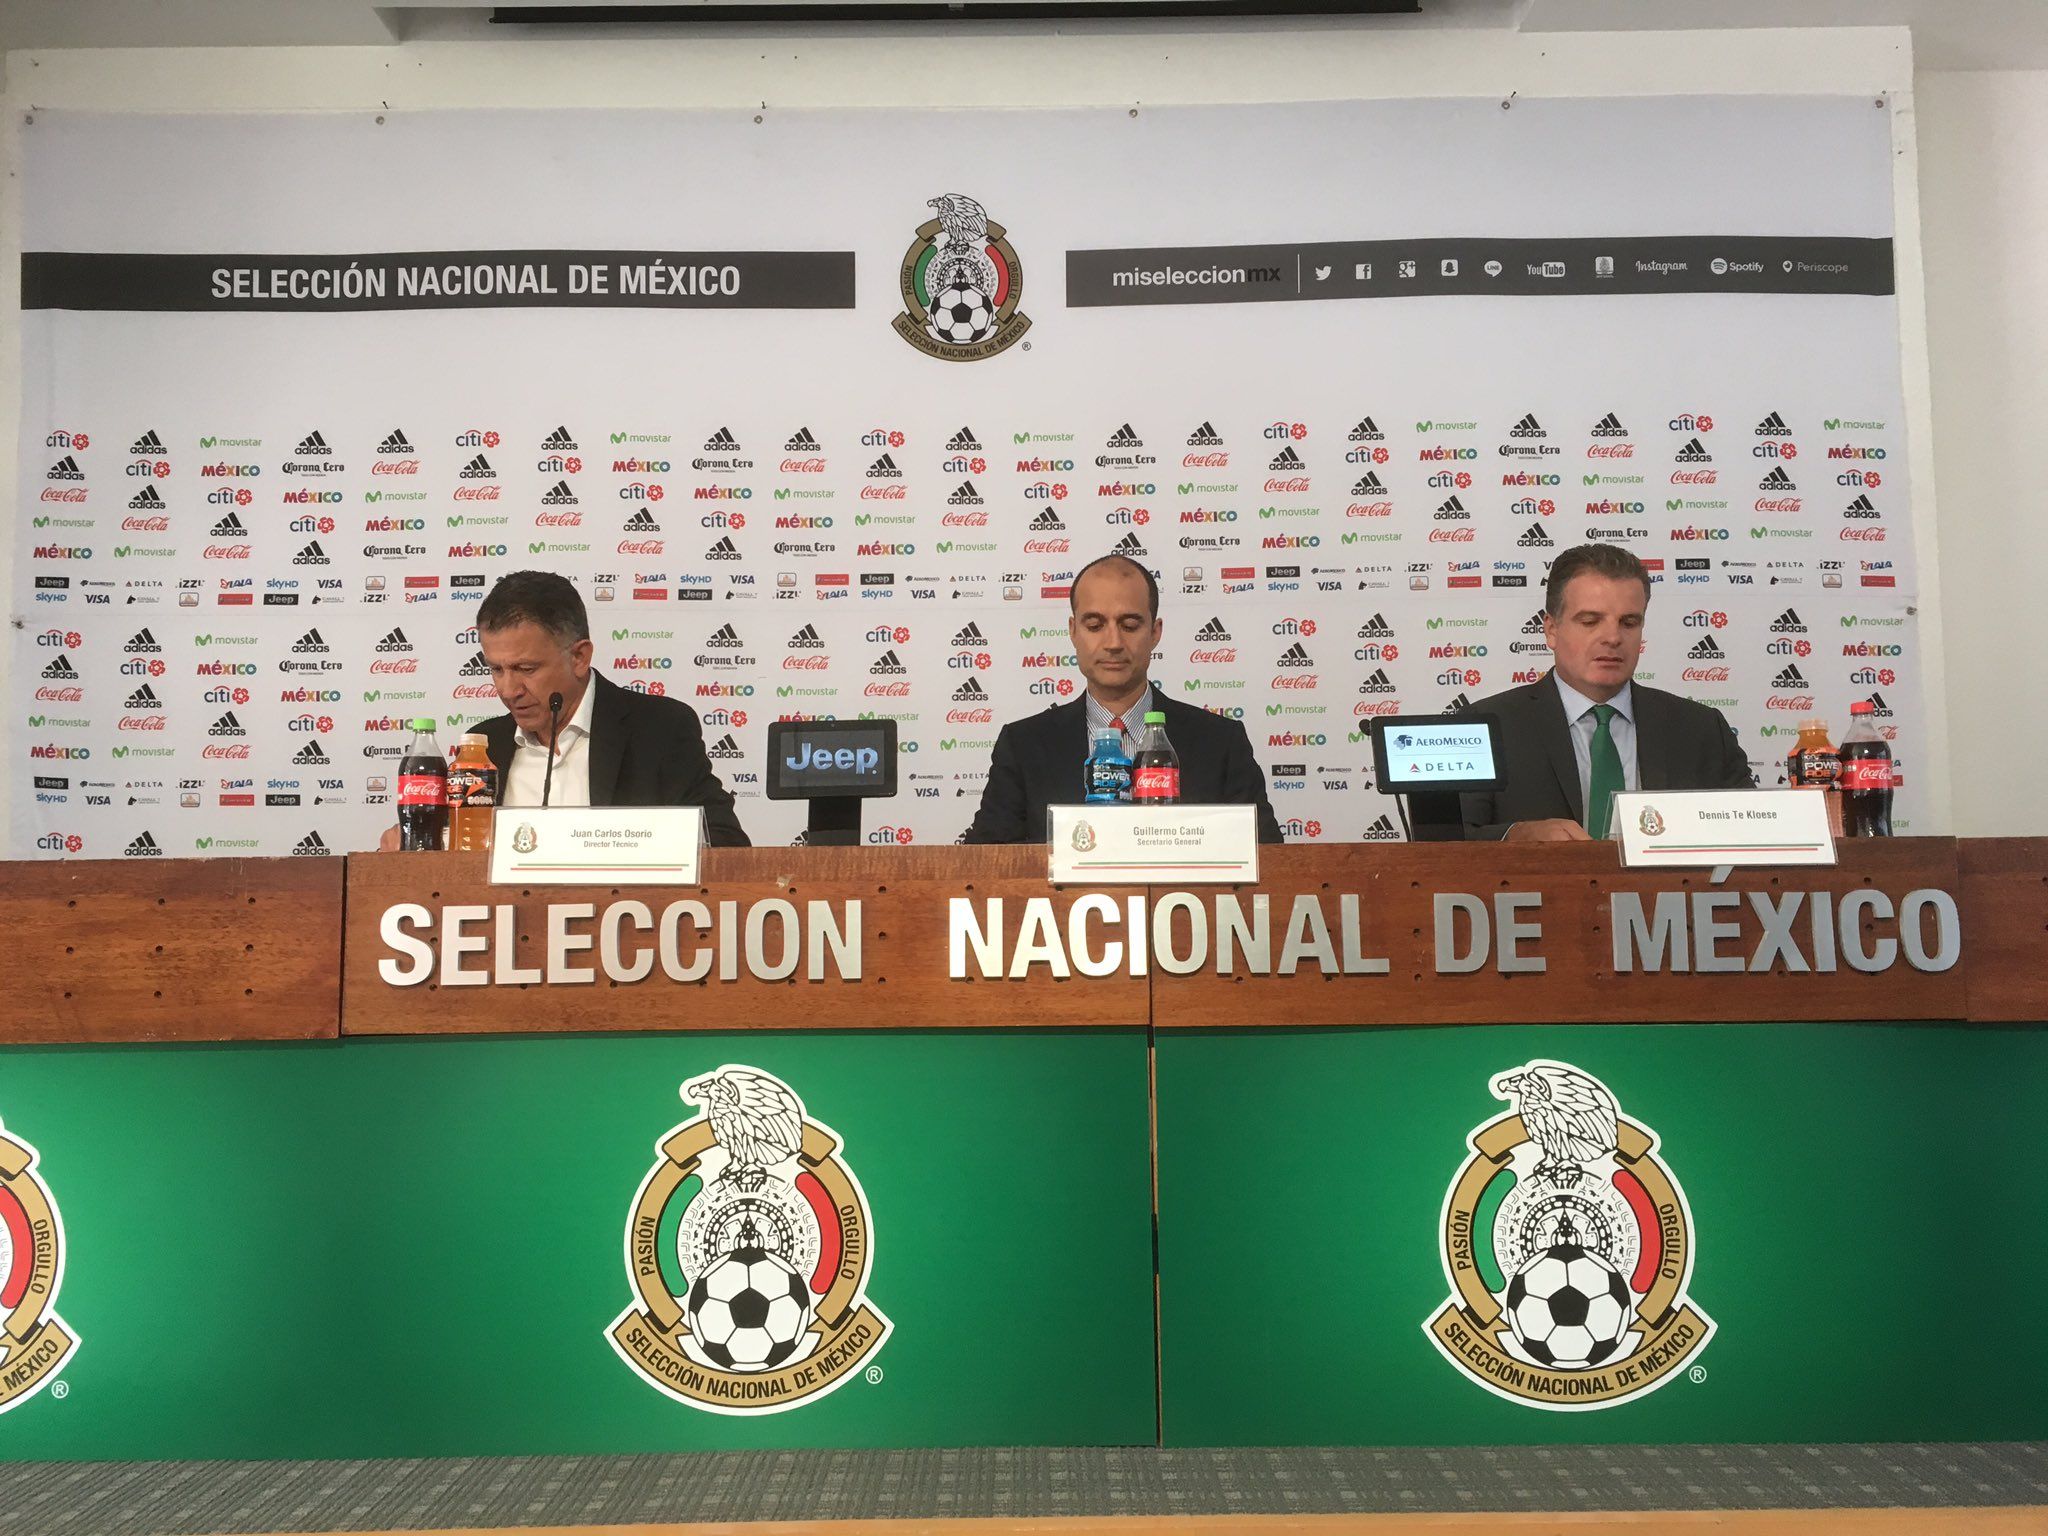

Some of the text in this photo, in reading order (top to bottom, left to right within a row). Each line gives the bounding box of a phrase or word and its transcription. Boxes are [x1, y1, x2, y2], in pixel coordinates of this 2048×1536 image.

[1635, 260, 1688, 275] Instagram
[1729, 261, 1764, 274] Spotify
[1797, 261, 1849, 274] Periscope
[211, 258, 742, 299] SELECCIÓN NACIONAL DE MÉXICO
[1008, 261, 1019, 299] ORGULLO
[939, 346, 984, 358] NACIONAL
[984, 342, 997, 353] DE
[1435, 422, 1477, 430] movistar
[1669, 414, 1694, 431] citi
[1264, 422, 1288, 439] citi
[1348, 430, 1384, 441] adidas
[1510, 427, 1547, 437] adidas
[1591, 426, 1628, 437] adidas
[1755, 425, 1792, 436] adidas
[46, 430, 70, 448] citi
[456, 430, 481, 446] citi
[861, 429, 886, 446] citi
[1033, 433, 1074, 441] movistar
[1107, 437, 1143, 448] adidas
[1187, 435, 1223, 446] adidas
[130, 443, 167, 454] adidas
[295, 444, 332, 455] adidas
[377, 443, 414, 453] adidas
[541, 440, 578, 450] adidas
[704, 441, 740, 451] adidas
[785, 441, 821, 451] adidas
[946, 440, 982, 450] adidas
[1753, 441, 1778, 457] citi
[1346, 446, 1370, 463] citi
[1675, 452, 1712, 462] adidas
[126, 459, 151, 476] citi
[538, 455, 563, 472] citi
[943, 456, 967, 472] citi
[1269, 460, 1305, 470] adidas
[47, 470, 84, 480] adidas
[460, 468, 496, 478] adidas
[866, 467, 902, 477] adidas
[1837, 469, 1862, 486] citi
[1428, 471, 1453, 488] citi
[1602, 475, 1644, 483] movistar
[1024, 482, 1049, 499] citi
[1197, 484, 1238, 492] movistar
[1351, 484, 1387, 495] adidas
[1759, 480, 1796, 490] adidas
[208, 487, 234, 504] citi
[385, 492, 427, 500] movistar
[620, 483, 645, 499] citi
[793, 490, 835, 498] movistar
[128, 498, 166, 509] adidas
[542, 494, 578, 504] adidas
[947, 494, 984, 505] adidas
[1680, 559, 1705, 569] Jeep
[1271, 567, 1295, 576] Jeep
[40, 578, 65, 588] Jeep
[730, 575, 754, 584] VISA
[865, 574, 889, 584] Jeep
[1728, 575, 1753, 584] VISA
[1317, 582, 1342, 591] VISA
[85, 595, 110, 603] VISA
[37, 630, 63, 646] citi
[124, 642, 161, 652] adidas
[1850, 667, 1876, 684] citi
[1771, 678, 1809, 688] adidas
[1285, 706, 1327, 714] movistar
[1415, 737, 1482, 747] AEROMEXICO
[786, 742, 878, 775] Jeep
[1425, 761, 1475, 772] DELTA
[1323, 781, 1348, 790] VISA
[1698, 810, 1777, 820] Dennis Te Kloese
[570, 828, 652, 838] Juan Carlos Osorio
[1133, 826, 1205, 836] Guillermo Cantú
[584, 840, 610, 848] Director
[1137, 838, 1202, 846] Secretario General
[378, 866, 1961, 988] SELECCION NACIONAL DE MÉXICO
[840, 1204, 860, 1280] ORGULLO
[1453, 1209, 1471, 1271] PASIÓN
[1659, 1203, 1681, 1280] ORGULLO
[635, 1216, 656, 1277] PASIÓN
[33, 1218, 52, 1295] ORGULLO
[3, 1339, 59, 1390] MÉXICO
[625, 1323, 872, 1399] SELECCIÓN NACIONAL DE MÉXICO
[1444, 1322, 1695, 1396] SELECCIÓN NACIONAL DE MÉXICO
